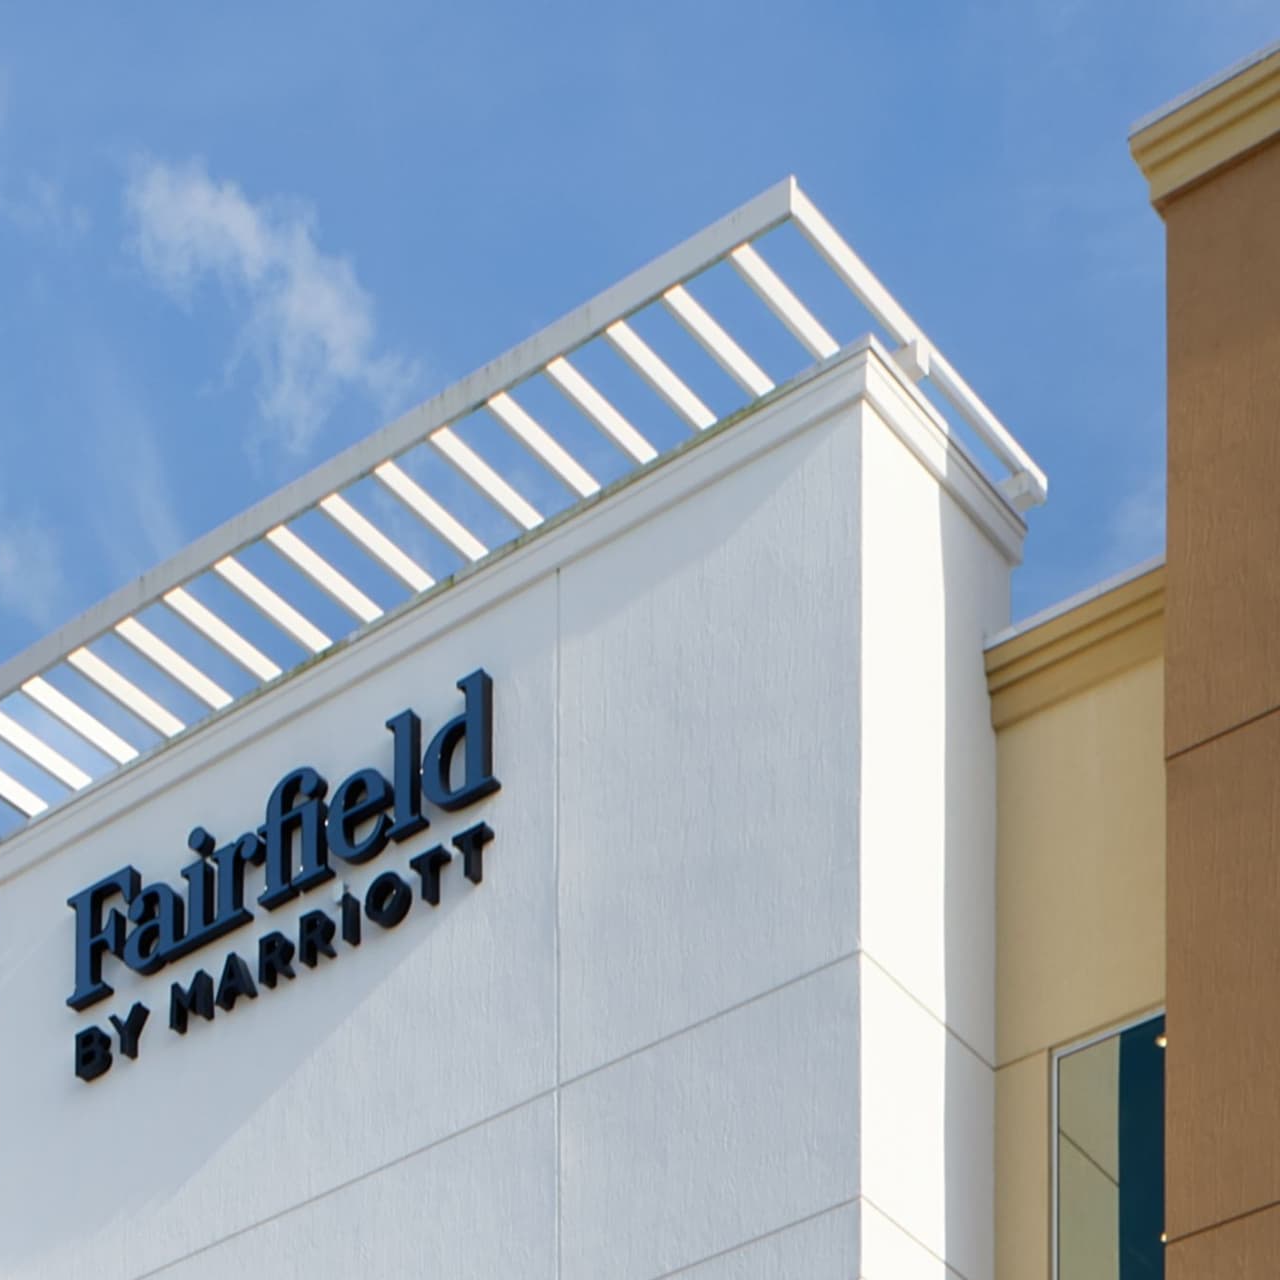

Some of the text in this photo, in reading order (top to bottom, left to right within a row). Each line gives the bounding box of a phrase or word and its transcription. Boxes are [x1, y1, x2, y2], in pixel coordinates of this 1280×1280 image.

[66, 667, 502, 1013] Fairfield
[74, 821, 496, 1084] BY MARRIOTT
